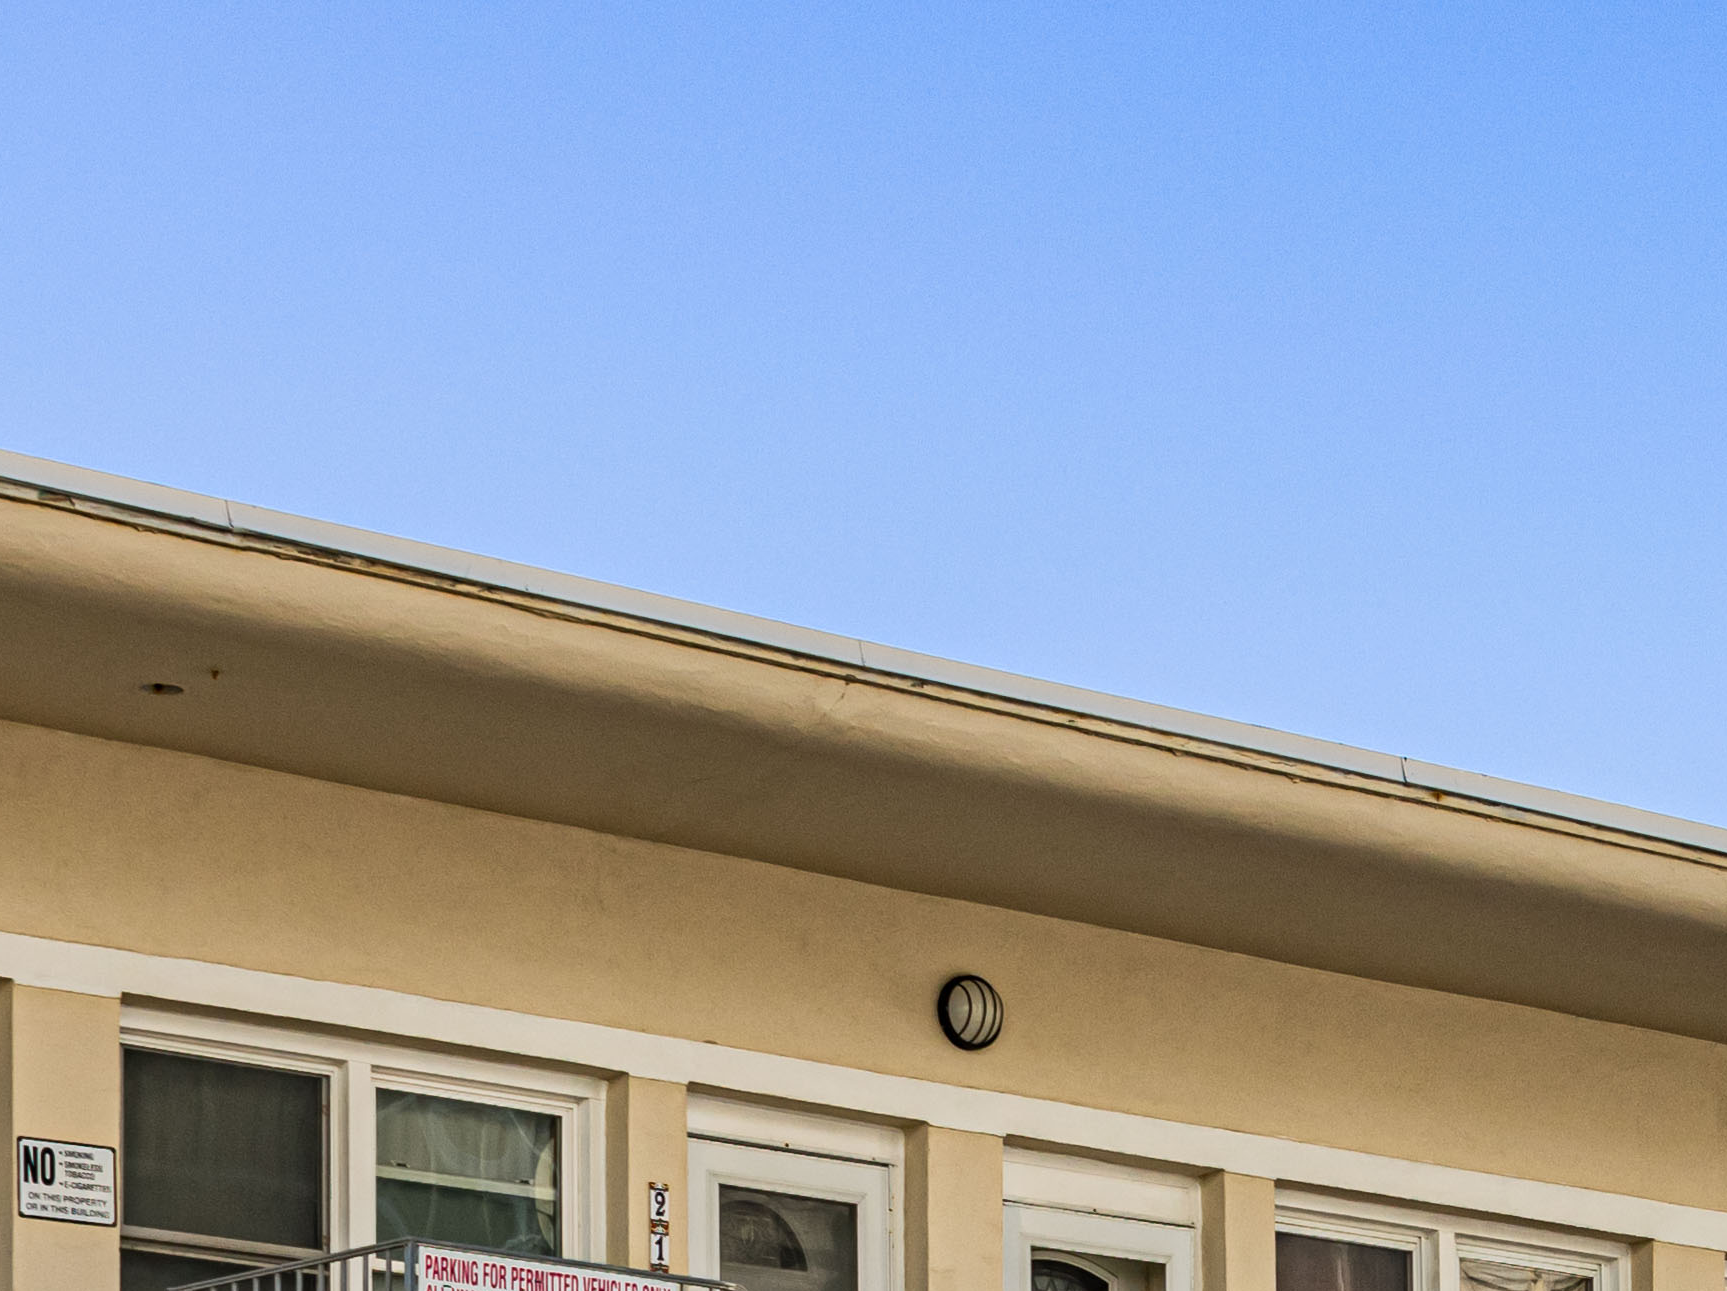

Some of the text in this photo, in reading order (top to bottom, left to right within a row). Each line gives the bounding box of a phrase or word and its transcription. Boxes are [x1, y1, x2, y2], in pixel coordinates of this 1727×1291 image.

[23, 1145, 55, 1186] NO
[425, 1254, 478, 1286] PARKING
[483, 1262, 507, 1289] FOR
